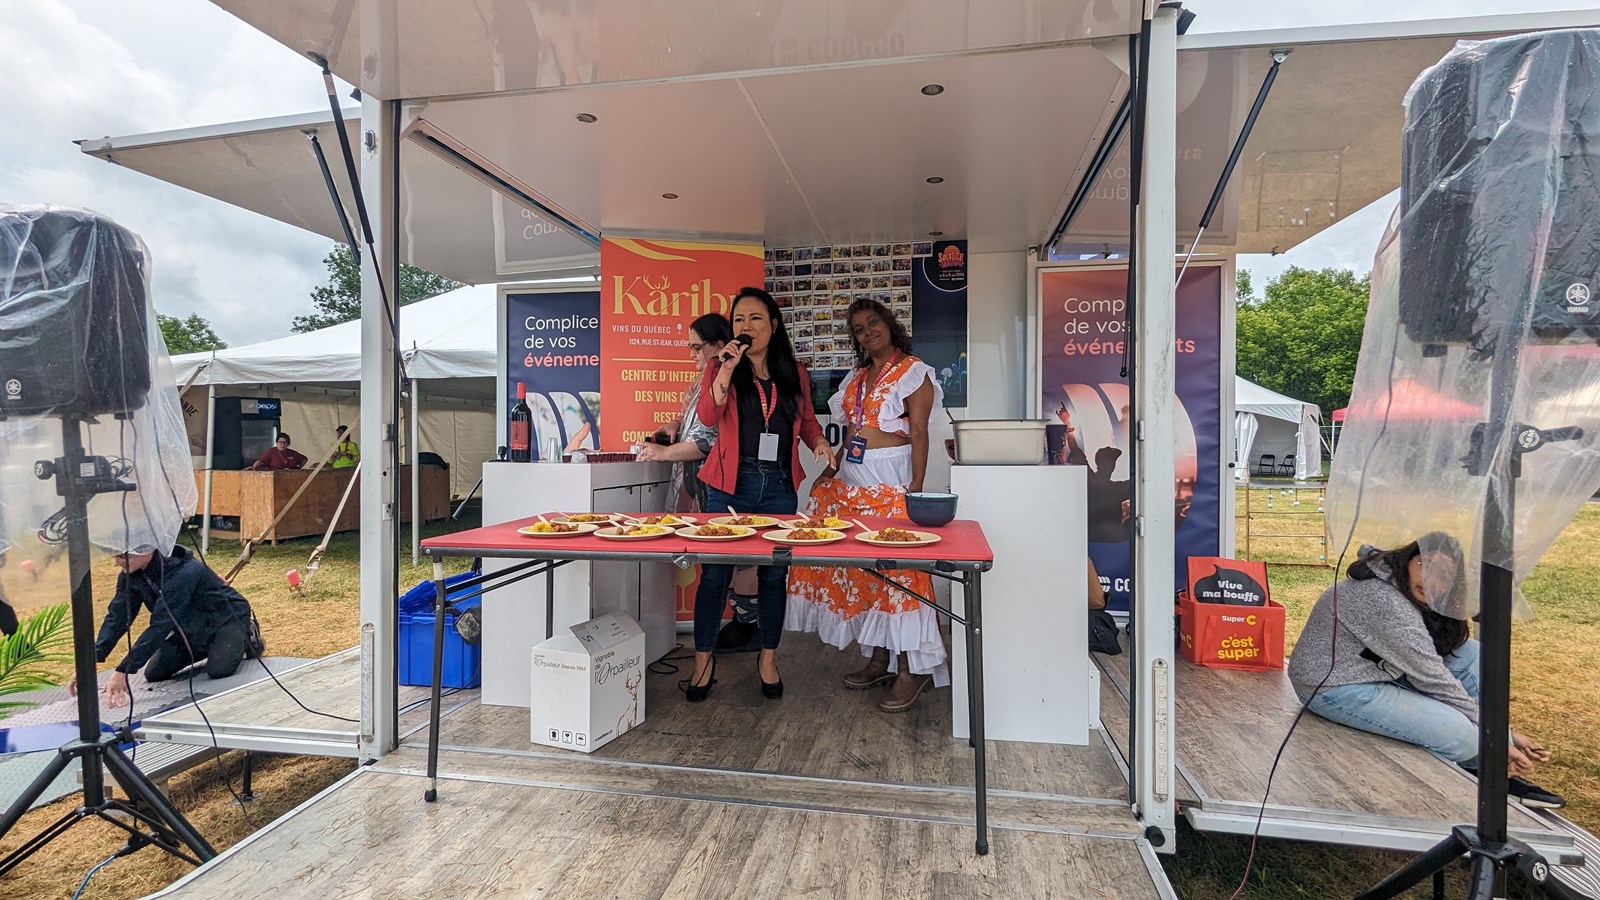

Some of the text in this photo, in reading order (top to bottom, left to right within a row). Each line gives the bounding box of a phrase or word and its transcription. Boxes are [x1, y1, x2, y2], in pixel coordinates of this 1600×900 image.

[612, 275, 736, 317] Karib
[1064, 297, 1126, 316] Comp
[525, 314, 599, 333] Complice
[612, 323, 671, 335] VINS DU QUÉBEC
[1064, 318, 1089, 335] de
[524, 334, 577, 349] de vos
[641, 338, 653, 346] RUE
[674, 337, 690, 347] QUÉBE
[523, 352, 600, 368] événeme
[621, 369, 657, 382] CENTRE
[635, 390, 652, 402] DES
[655, 391, 676, 402] VINS
[257, 402, 277, 411] pepsi
[622, 430, 653, 443] COMP
[1114, 577, 1130, 593] CO
[1217, 580, 1243, 590] Vive
[1202, 590, 1259, 602] ma bouffe
[1222, 615, 1257, 625] Super C
[1221, 635, 1254, 648] c'est
[594, 650, 615, 663] Vignoble
[1217, 647, 1260, 661] super
